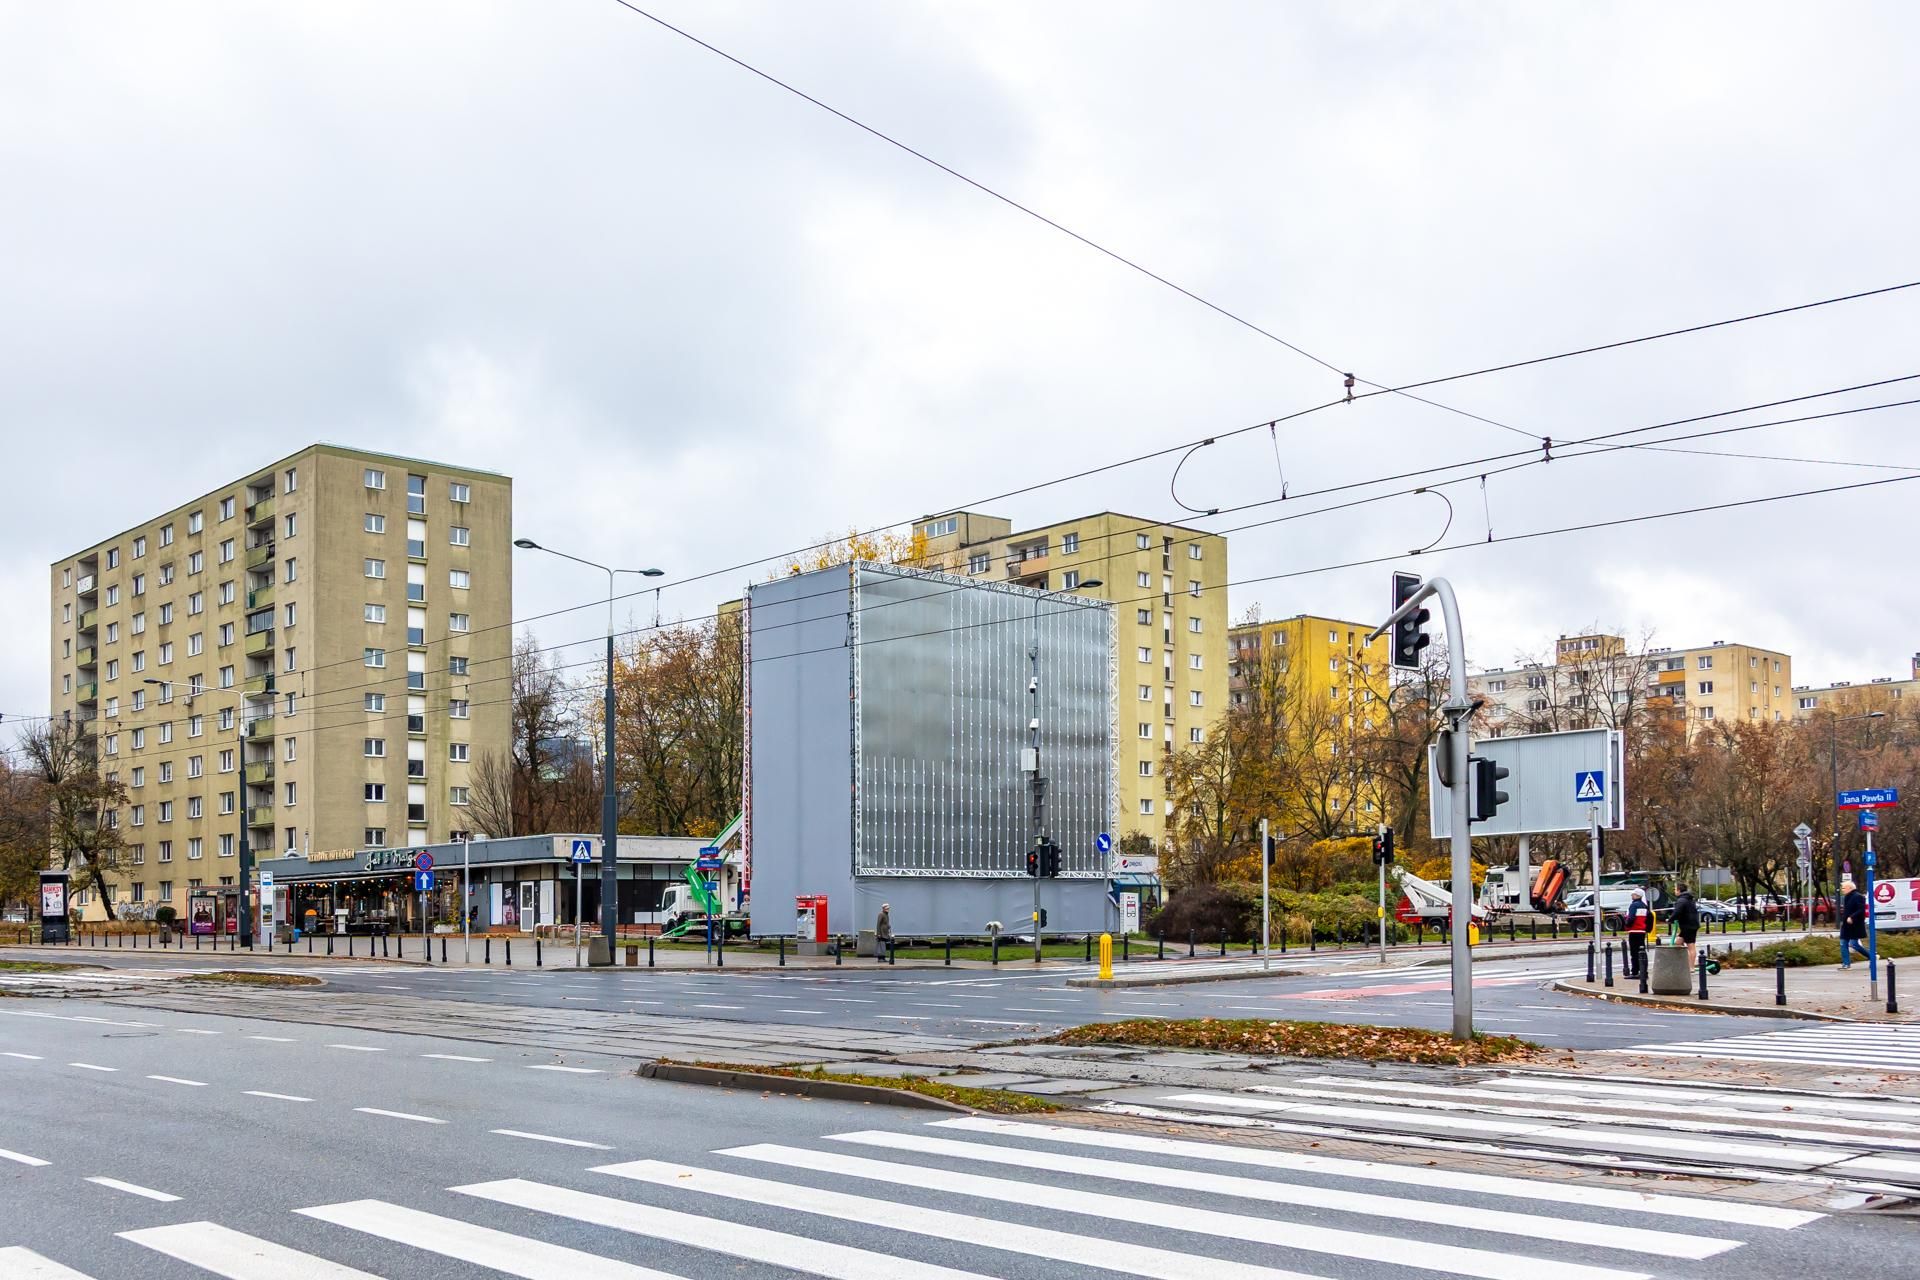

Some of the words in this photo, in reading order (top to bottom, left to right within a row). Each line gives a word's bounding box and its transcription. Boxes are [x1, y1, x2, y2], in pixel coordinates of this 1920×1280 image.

[1843, 796, 1860, 804] Jana
[1861, 793, 1885, 802] Pawła
[1886, 793, 1892, 801] II
